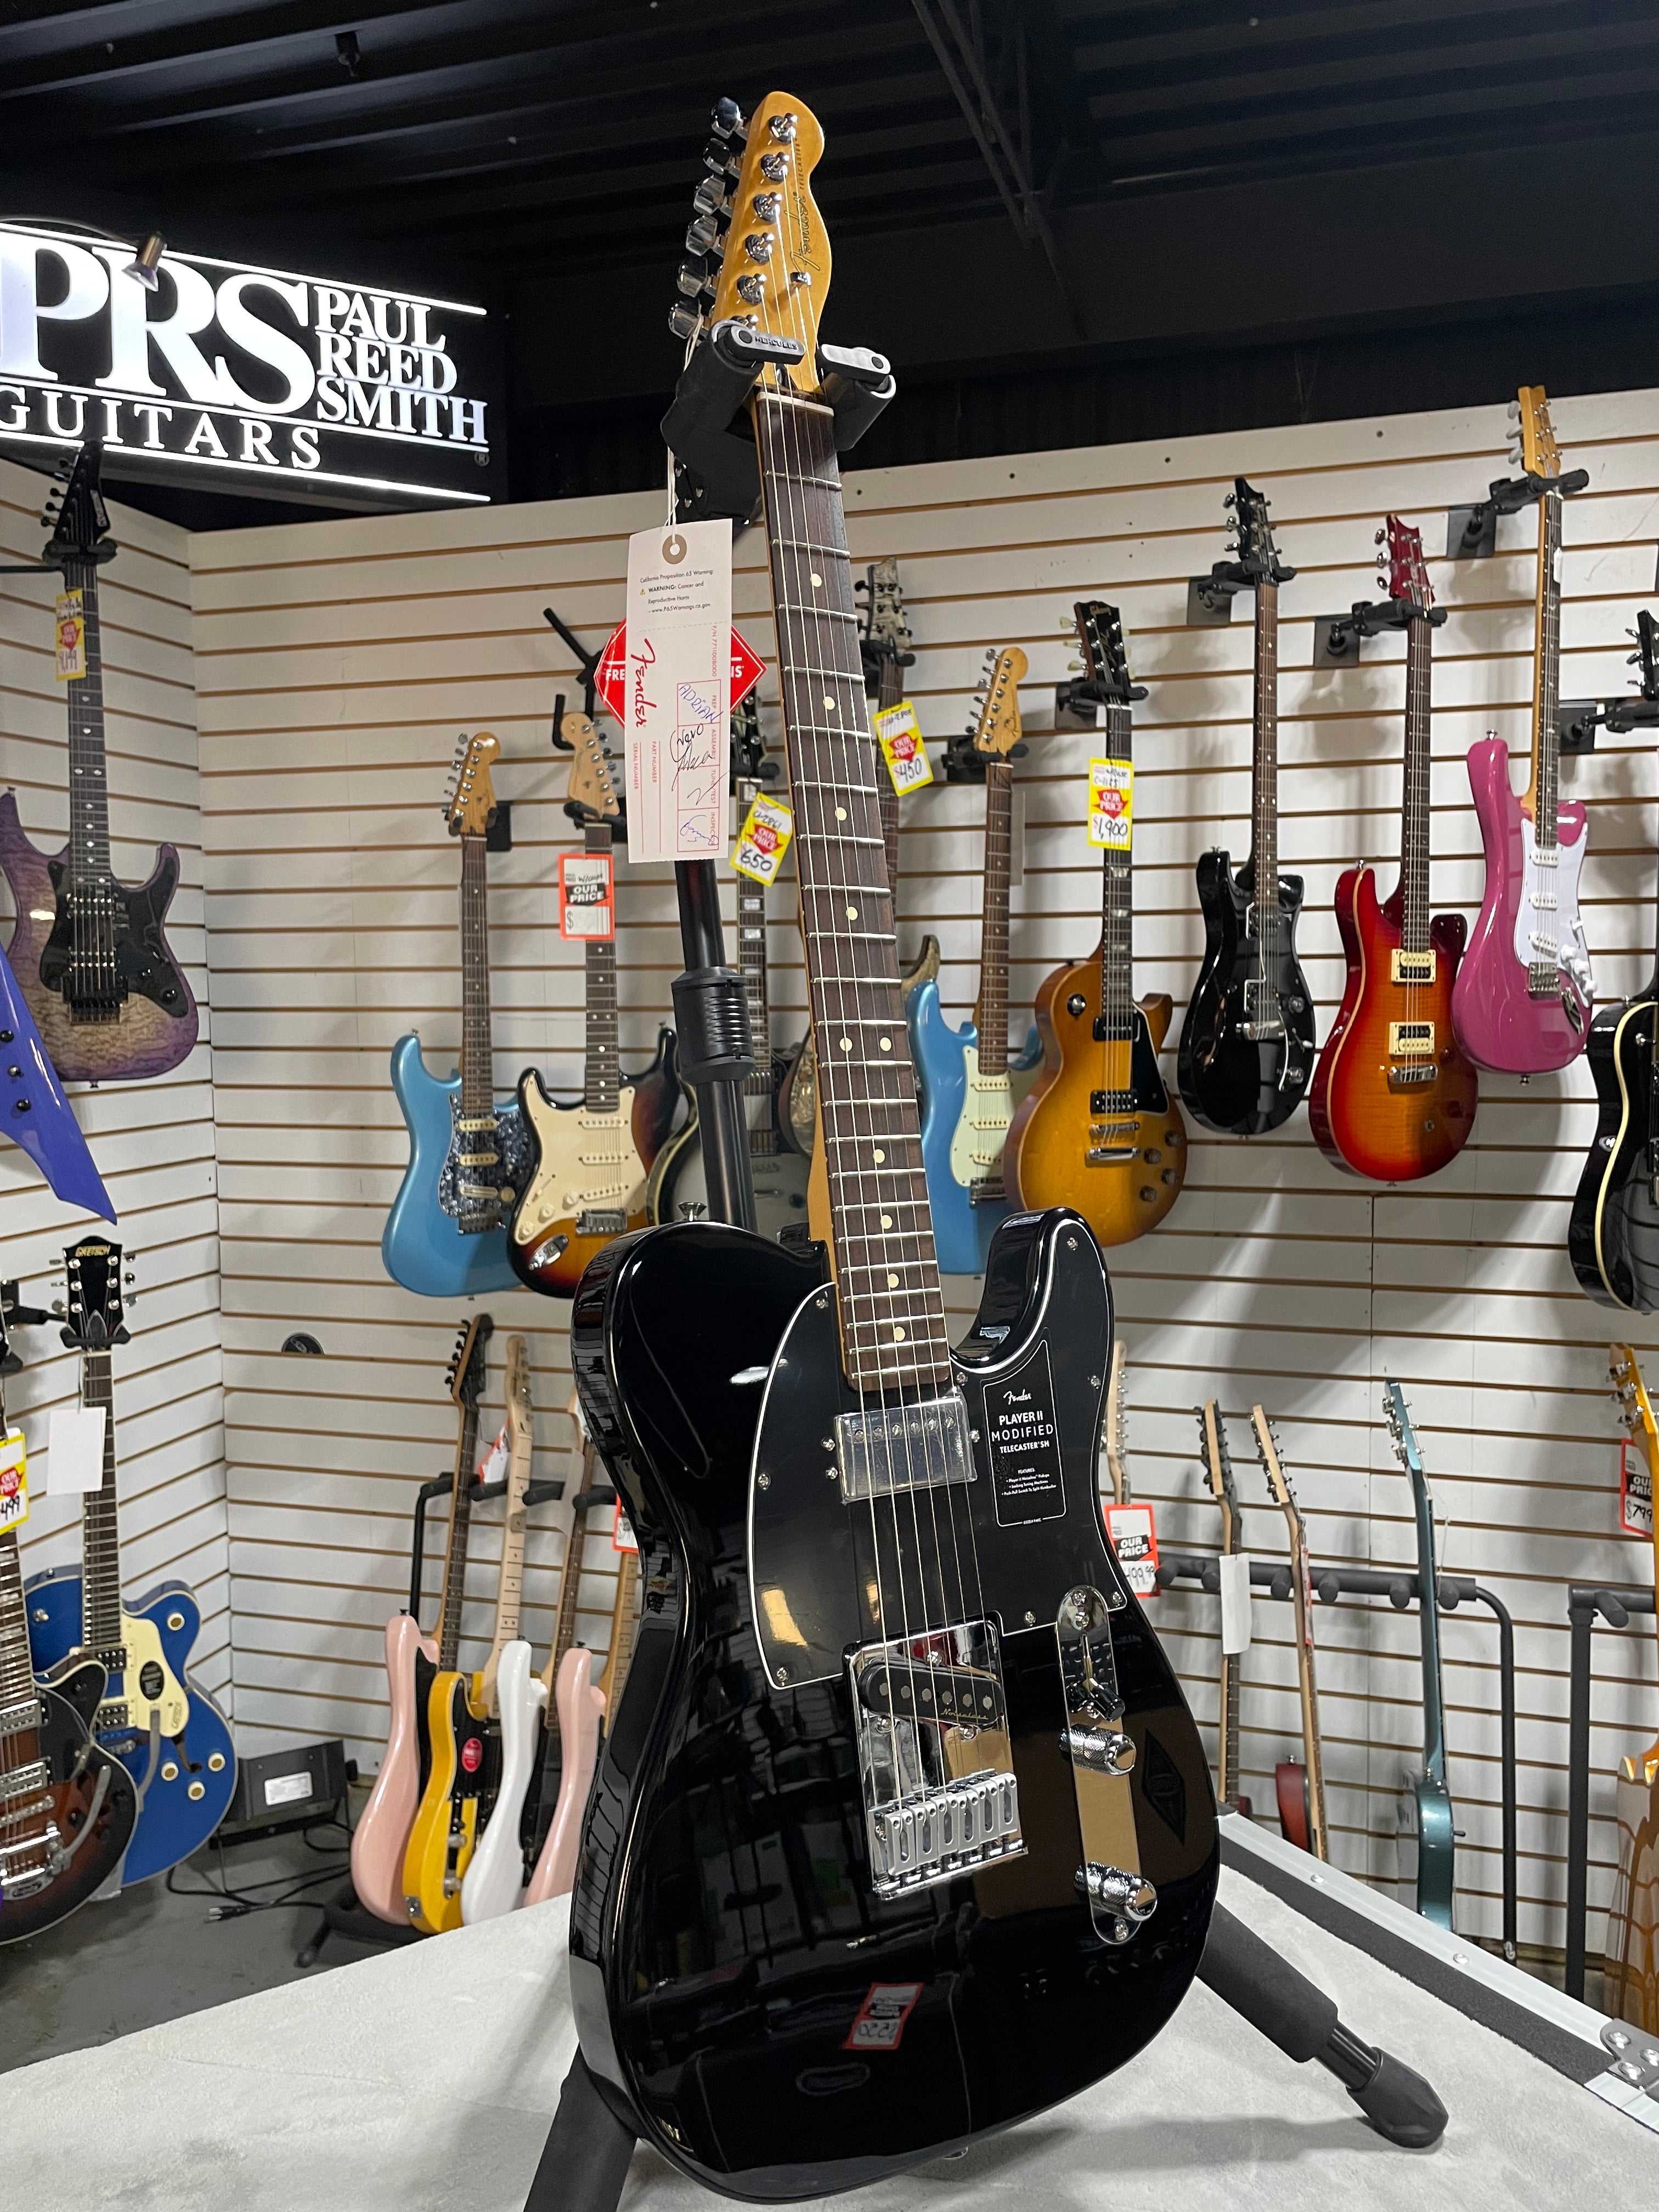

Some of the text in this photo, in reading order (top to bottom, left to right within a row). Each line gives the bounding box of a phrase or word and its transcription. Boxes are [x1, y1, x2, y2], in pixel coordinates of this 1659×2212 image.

[784, 195, 820, 273] Fender
[0, 232, 316, 414] PRS
[313, 285, 446, 352] PAUL
[754, 336, 798, 350] HERCULES
[315, 331, 458, 394] REED
[317, 376, 489, 444] SMITH
[0, 386, 320, 470] GUITARS
[648, 584, 676, 592] WARNING:
[631, 638, 657, 727] Fender
[1103, 792, 1121, 802] OUR
[574, 884, 597, 894] OUR
[570, 891, 605, 904] PRICE
[1003, 1389, 1031, 1405] Fender
[999, 1410, 1043, 1426] PLAYER II
[991, 1424, 1053, 1442] MODIFIED
[1120, 1536, 1143, 1548] OUR
[1118, 1544, 1148, 1559] PRICE
